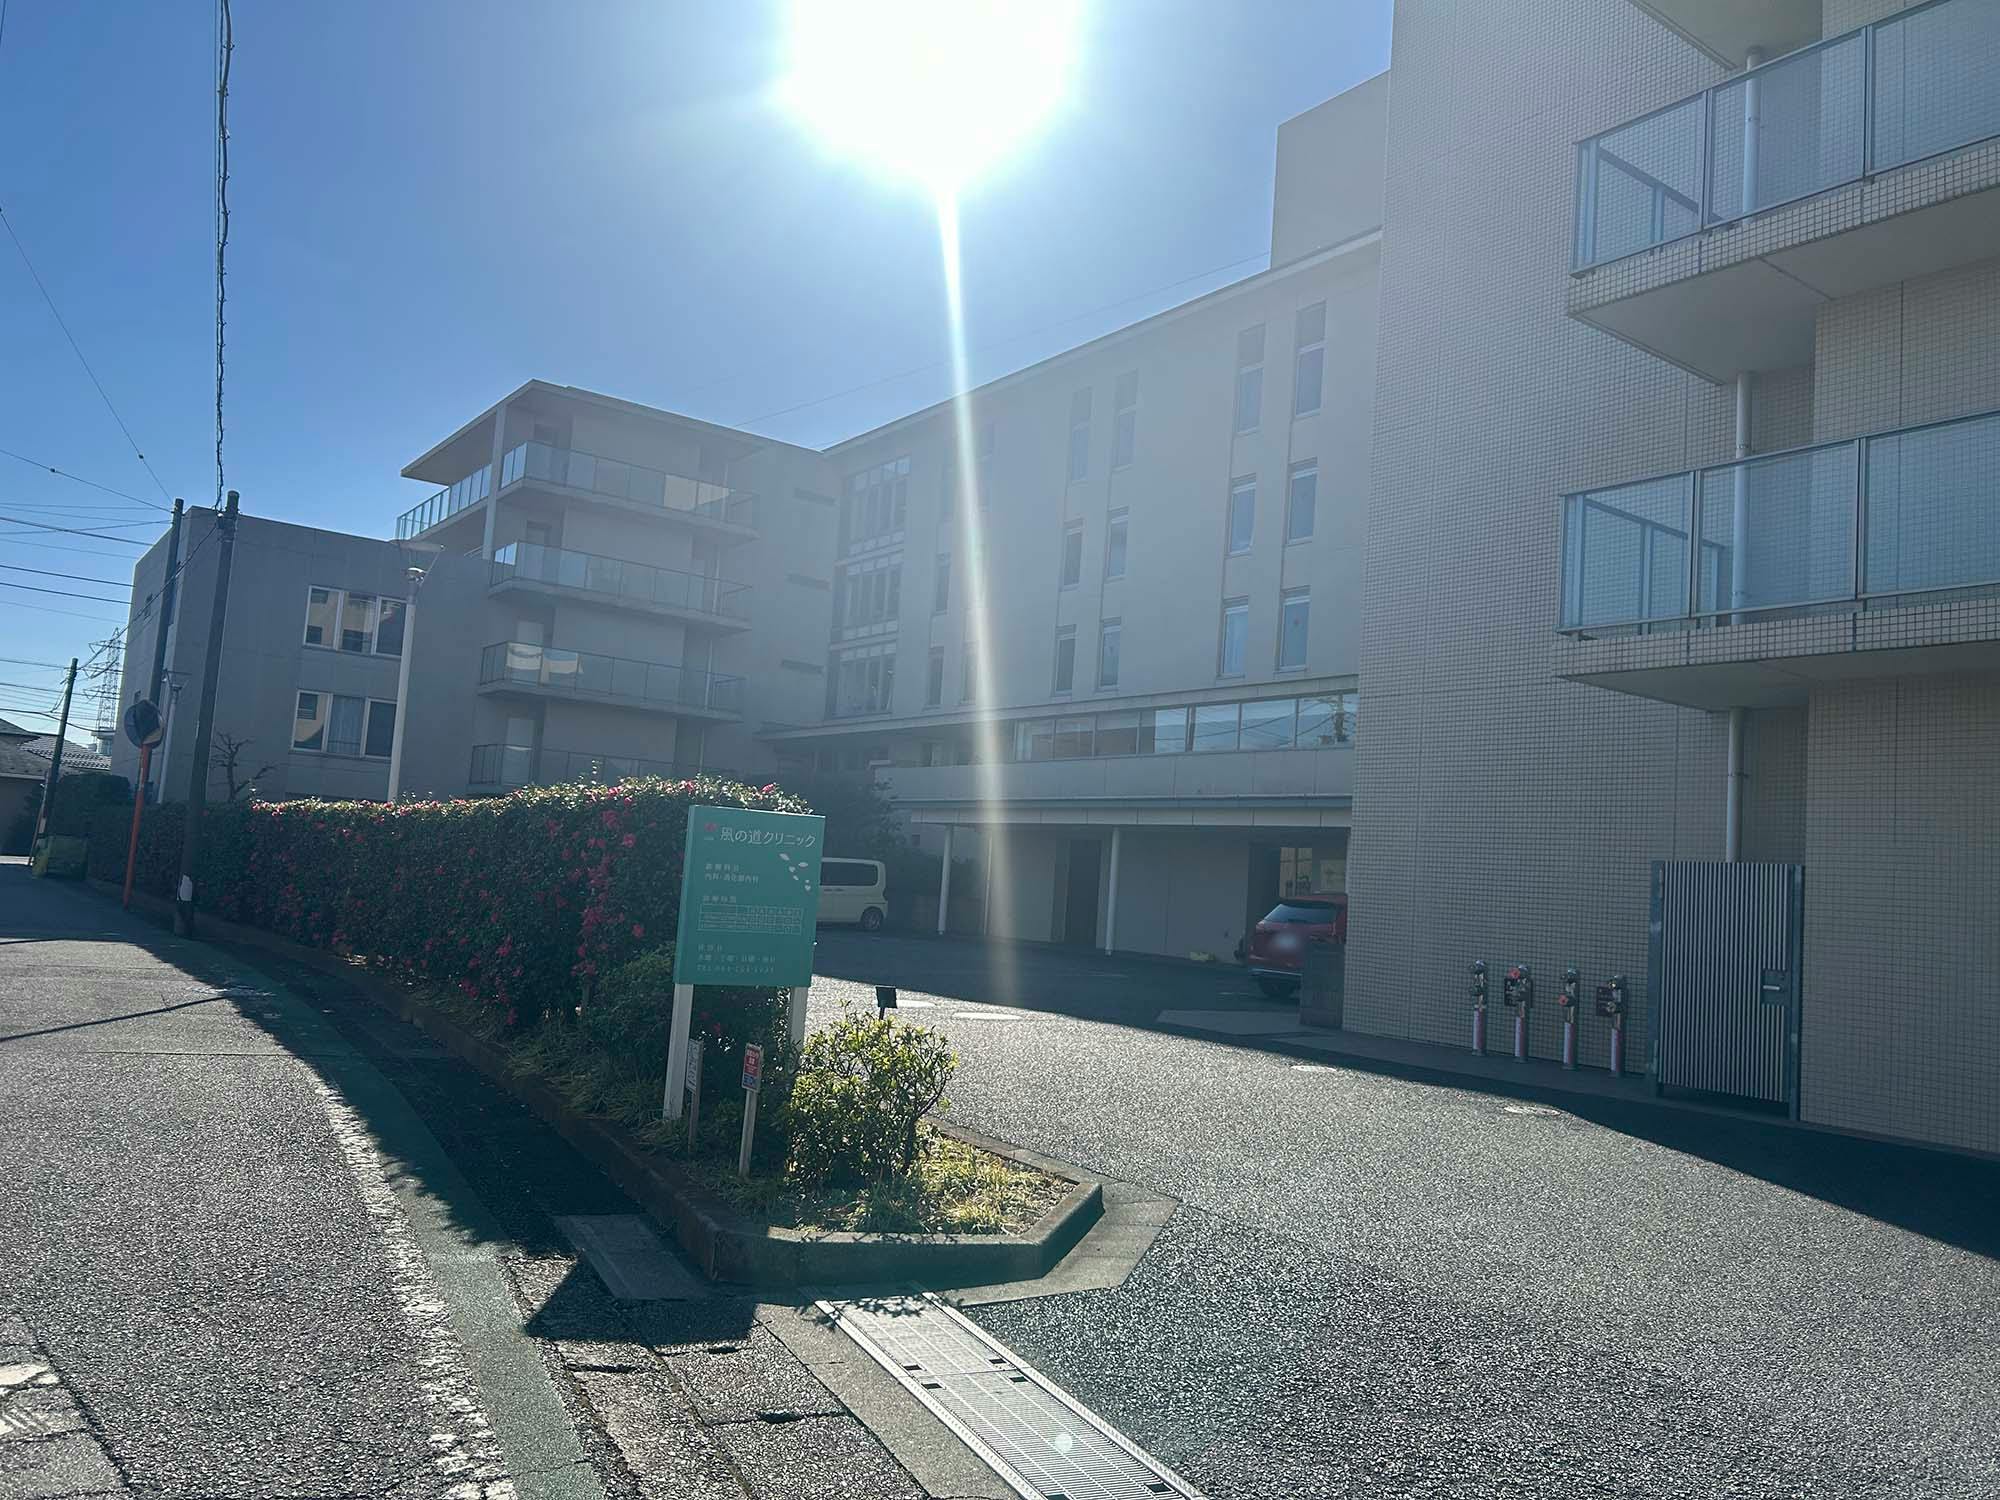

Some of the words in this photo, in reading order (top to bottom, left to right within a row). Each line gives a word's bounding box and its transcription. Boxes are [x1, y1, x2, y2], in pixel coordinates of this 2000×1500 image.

[720, 826, 816, 847] 風の道クリニック
